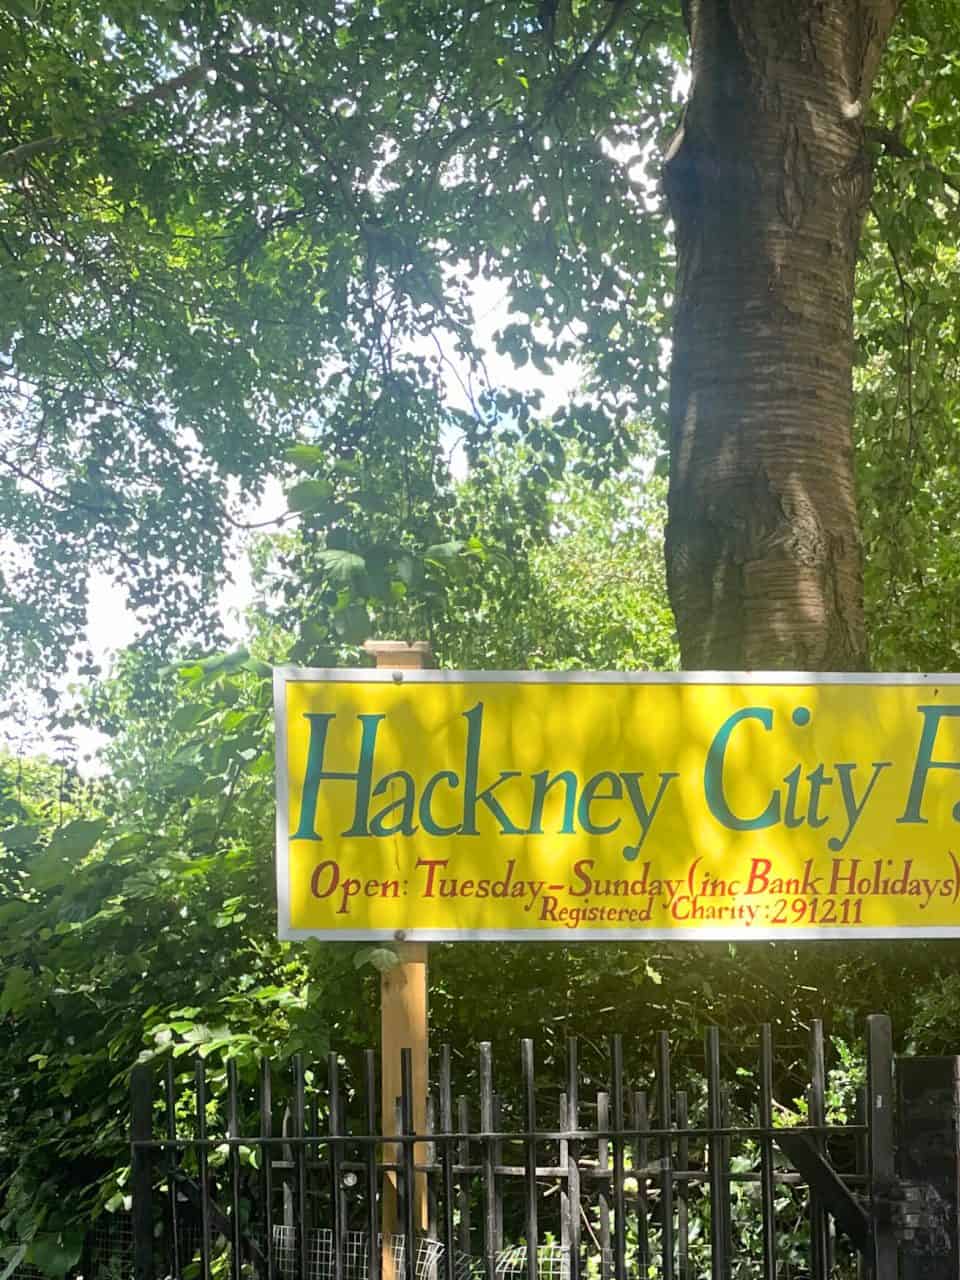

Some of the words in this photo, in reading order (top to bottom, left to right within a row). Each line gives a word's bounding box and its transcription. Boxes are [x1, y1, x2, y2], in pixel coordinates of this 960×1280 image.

[290, 702, 681, 861] Hackney
[703, 705, 893, 852] City
[310, 859, 408, 914] Open:
[743, 857, 824, 896] Bank
[539, 896, 653, 929] Registered
